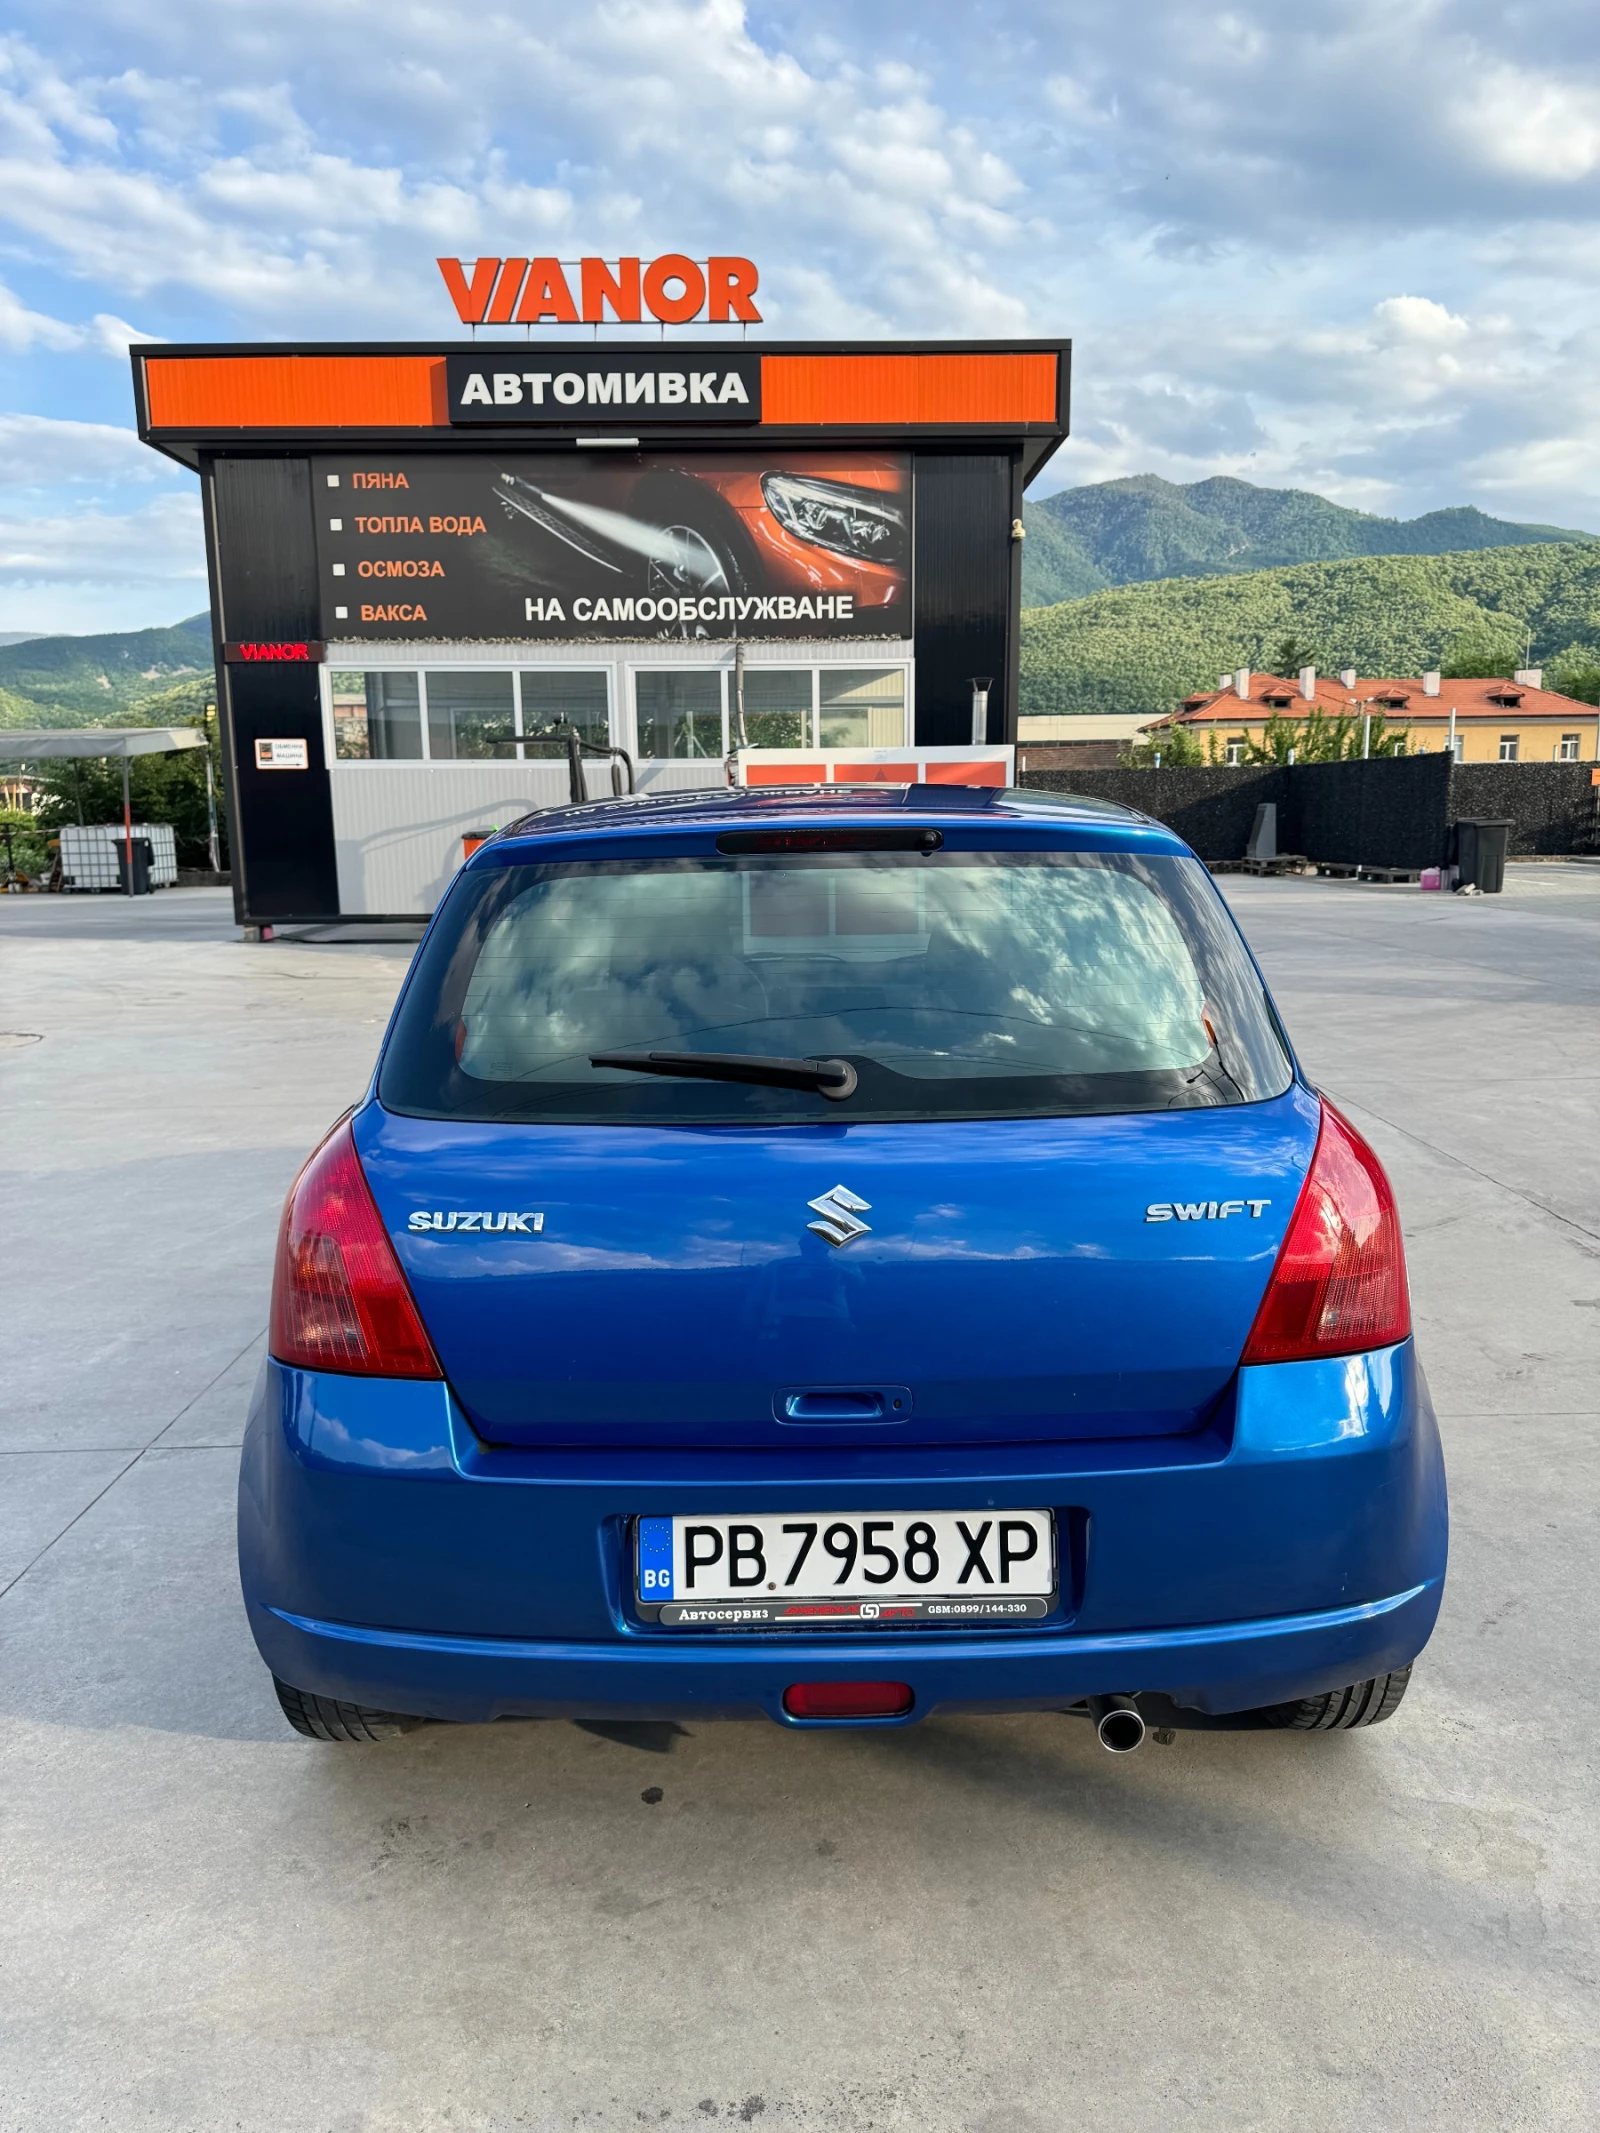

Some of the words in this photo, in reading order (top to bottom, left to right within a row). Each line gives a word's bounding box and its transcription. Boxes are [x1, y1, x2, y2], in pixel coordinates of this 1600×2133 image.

[436, 254, 763, 324] VIANOR
[460, 372, 749, 405] АВТОМИВКА
[352, 472, 409, 489] ПЯНА
[354, 516, 424, 533] ТОПЛА
[429, 516, 487, 536] ВОДА
[357, 560, 445, 577] ОСМОЗА
[360, 604, 427, 621] ВАКСА
[525, 598, 566, 621] НА
[572, 595, 854, 621] САМООБСЛУЖВАНЕ
[239, 643, 310, 660] VIANOR
[1145, 1199, 1272, 1222] SWIFT
[407, 1211, 545, 1234] SUZUKI
[782, 1520, 939, 1586] 7958
[644, 1569, 670, 1588] BG
[678, 1608, 769, 1622] Автосервиз
